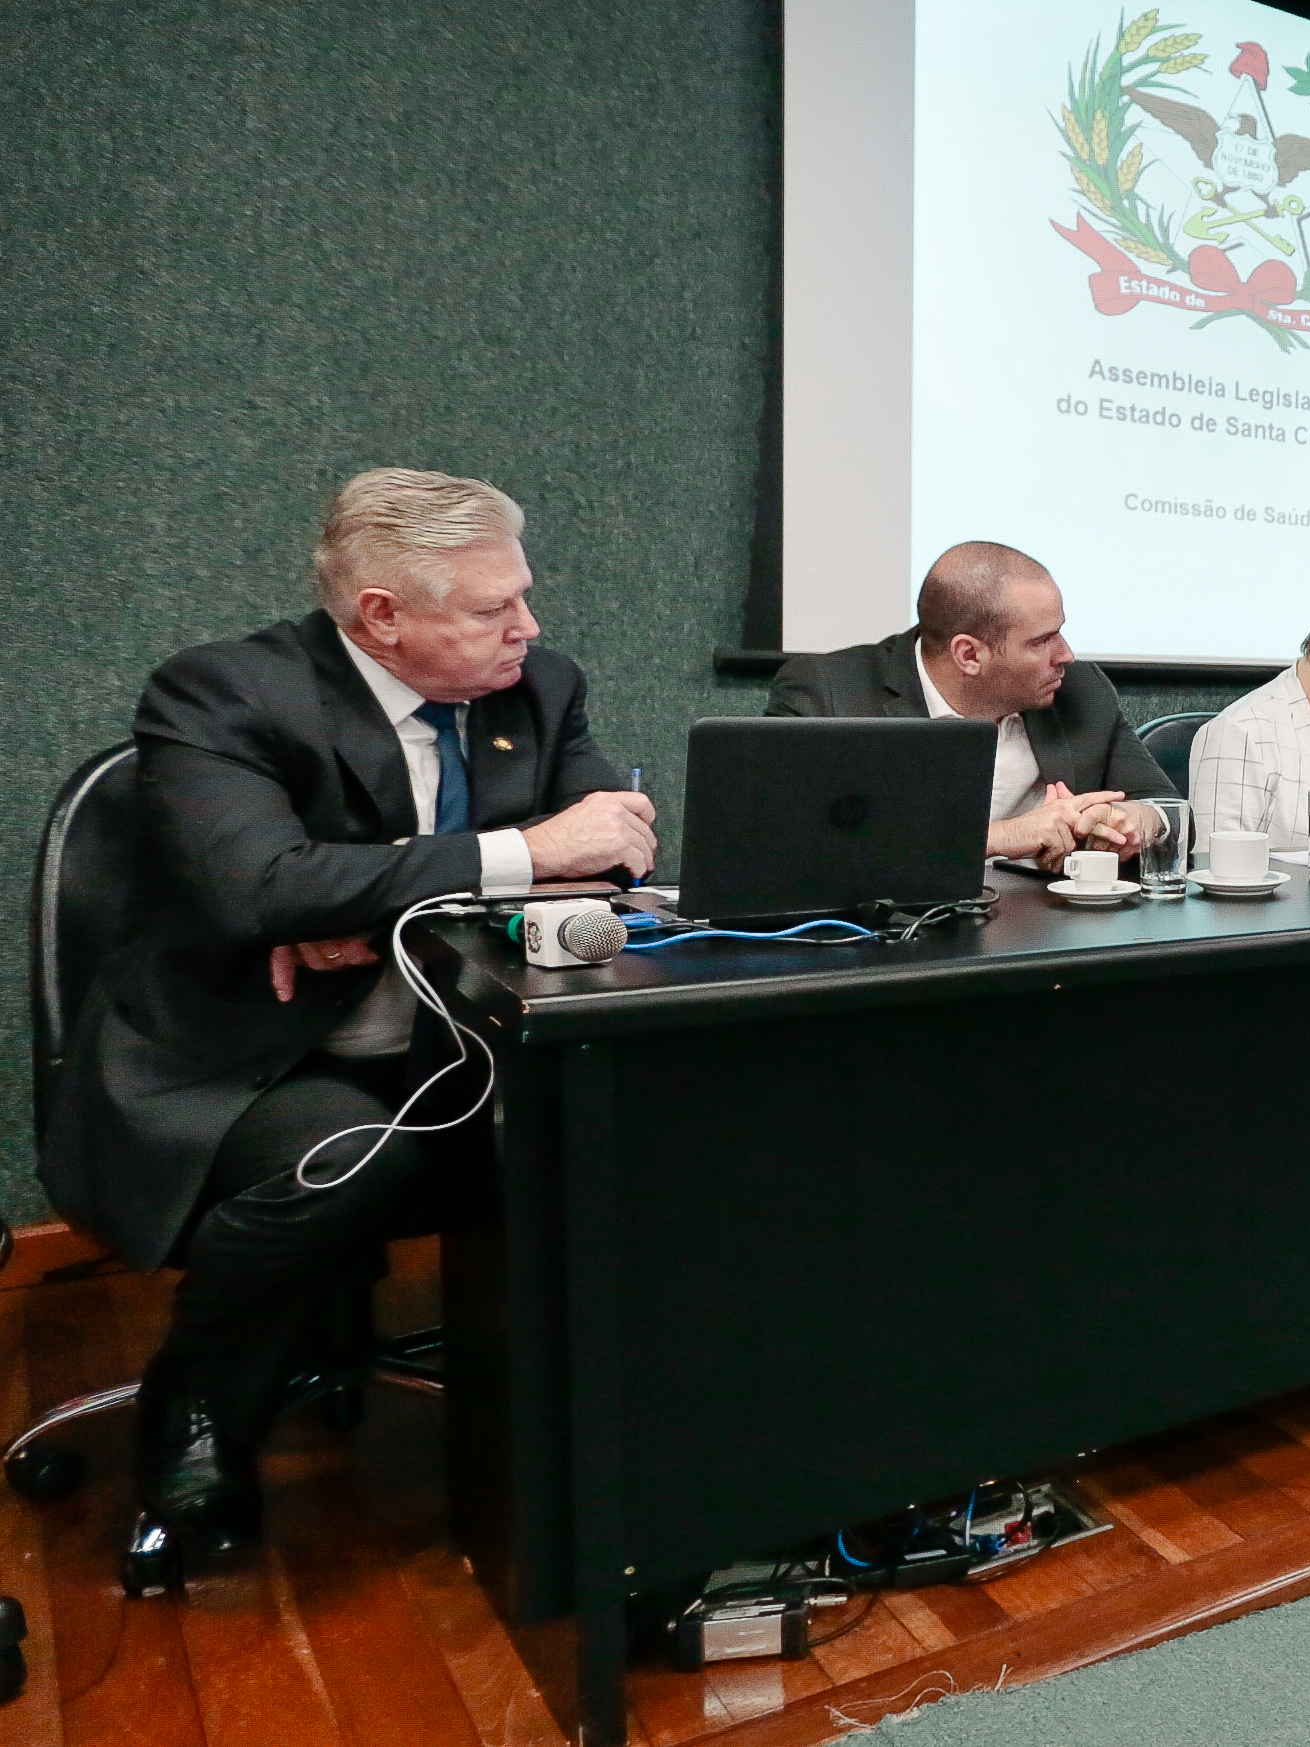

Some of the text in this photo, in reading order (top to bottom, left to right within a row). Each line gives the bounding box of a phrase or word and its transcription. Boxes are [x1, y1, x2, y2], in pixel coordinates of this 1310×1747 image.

[1118, 276, 1181, 302] Estado
[1267, 309, 1298, 325] Sta.
[1088, 358, 1226, 398] Assembleia
[1056, 393, 1088, 416] do
[1098, 397, 1182, 428] Estado
[1190, 412, 1217, 433] de
[1225, 415, 1287, 443] Santa
[1123, 492, 1227, 519] Comissão
[1233, 503, 1257, 522] de
